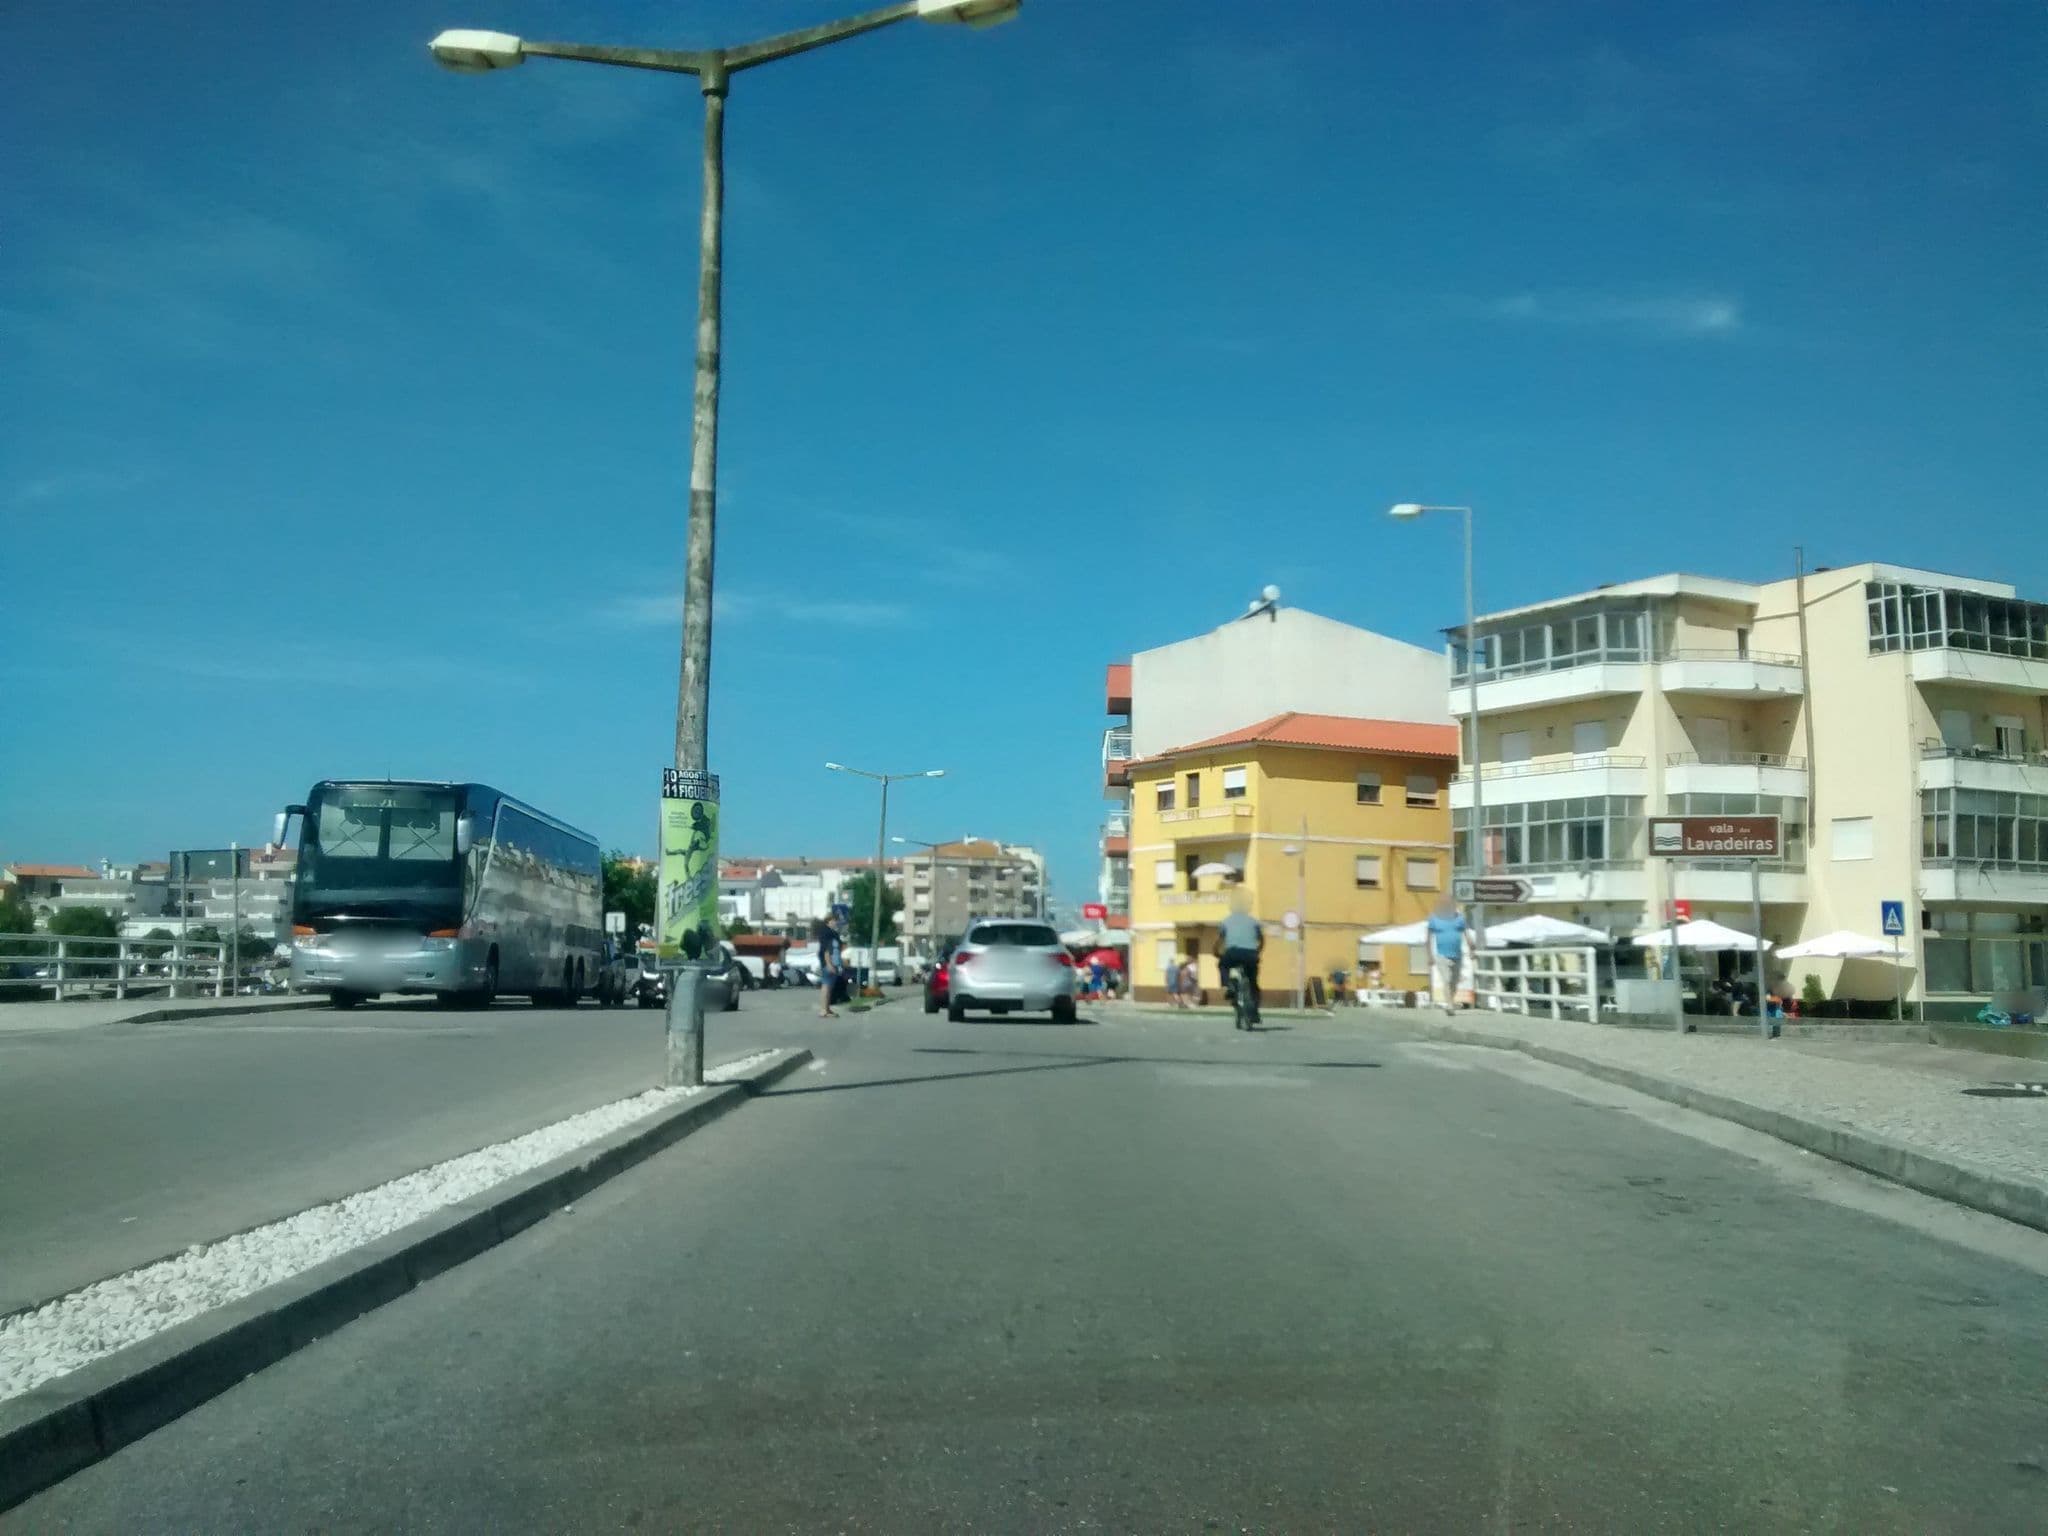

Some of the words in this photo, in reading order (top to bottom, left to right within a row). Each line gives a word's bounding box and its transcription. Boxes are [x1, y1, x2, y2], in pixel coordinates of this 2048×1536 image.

[664, 770, 678, 782] 10
[664, 783, 678, 797] 11
[1709, 823, 1734, 833] vala
[1686, 837, 1774, 851] Lavadeiras
